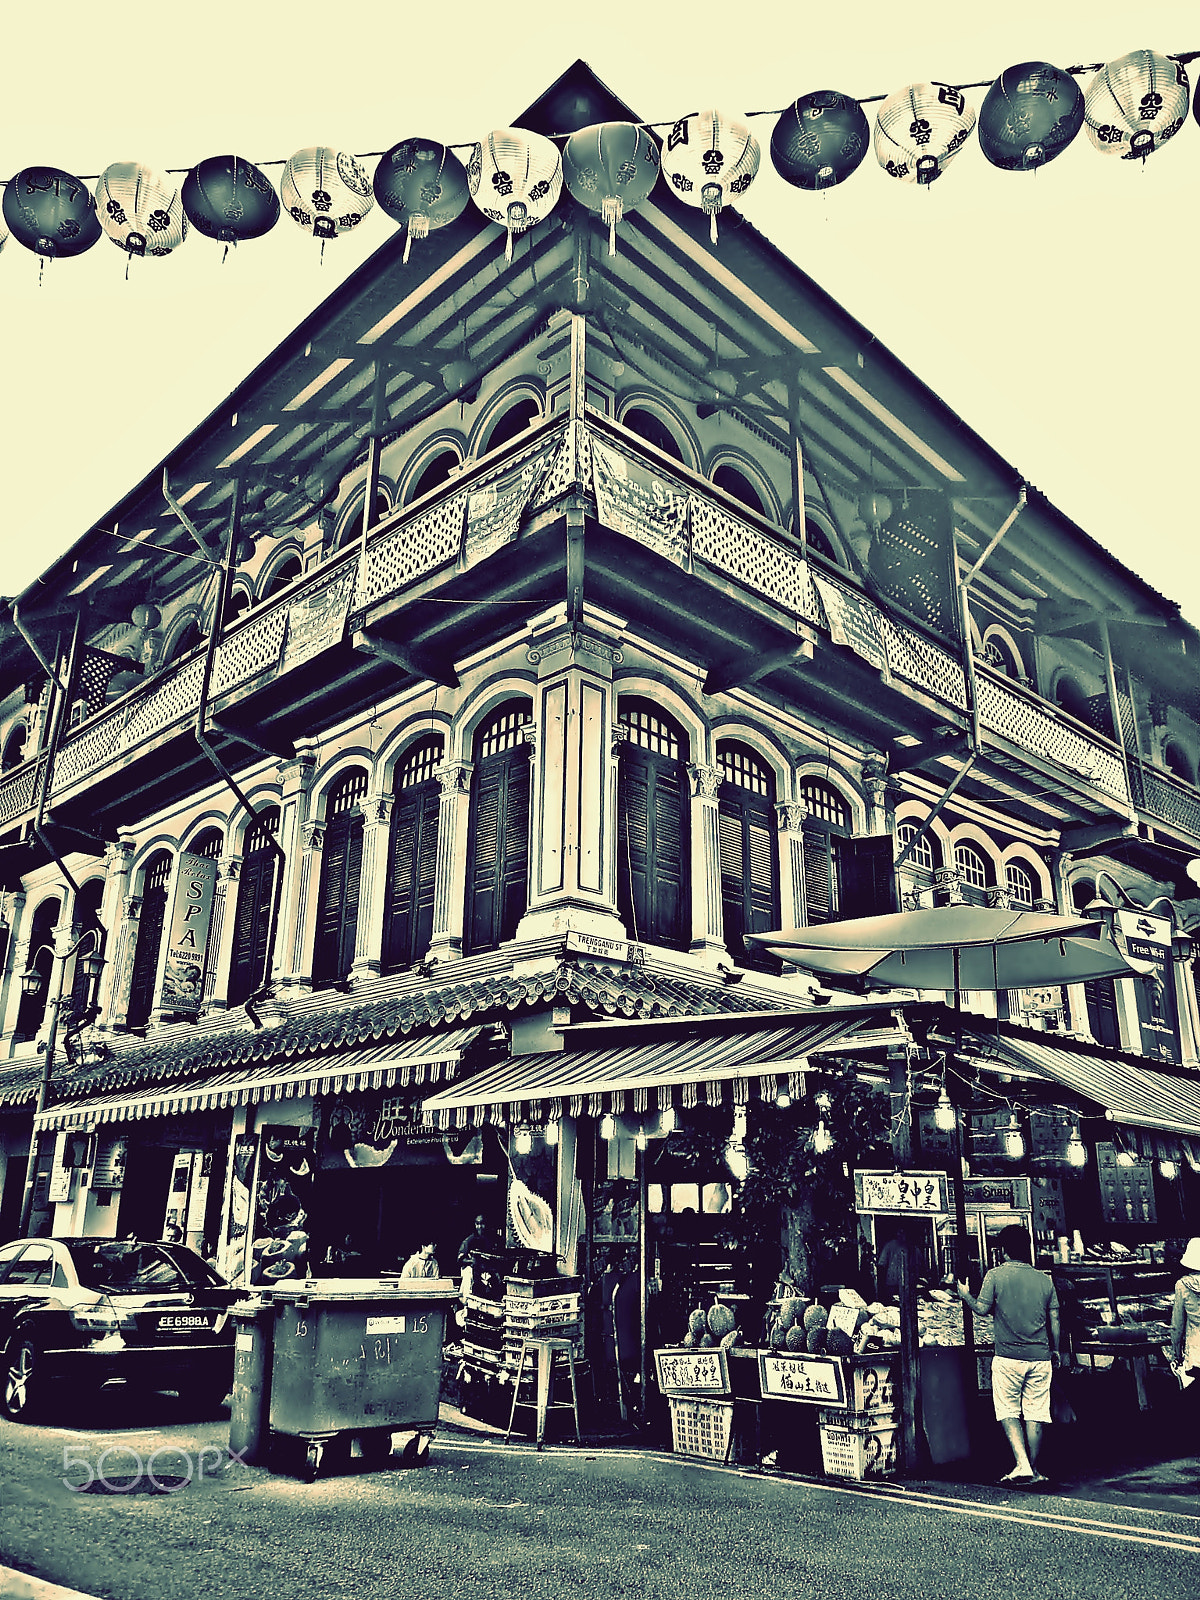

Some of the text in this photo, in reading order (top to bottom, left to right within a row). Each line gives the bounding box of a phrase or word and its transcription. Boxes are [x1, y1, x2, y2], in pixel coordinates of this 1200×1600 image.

[185, 857, 211, 869] Thai
[181, 867, 212, 881] Relax
[177, 880, 204, 948] SPA
[578, 935, 614, 949] TRENGGANU
[1131, 943, 1150, 955] Free
